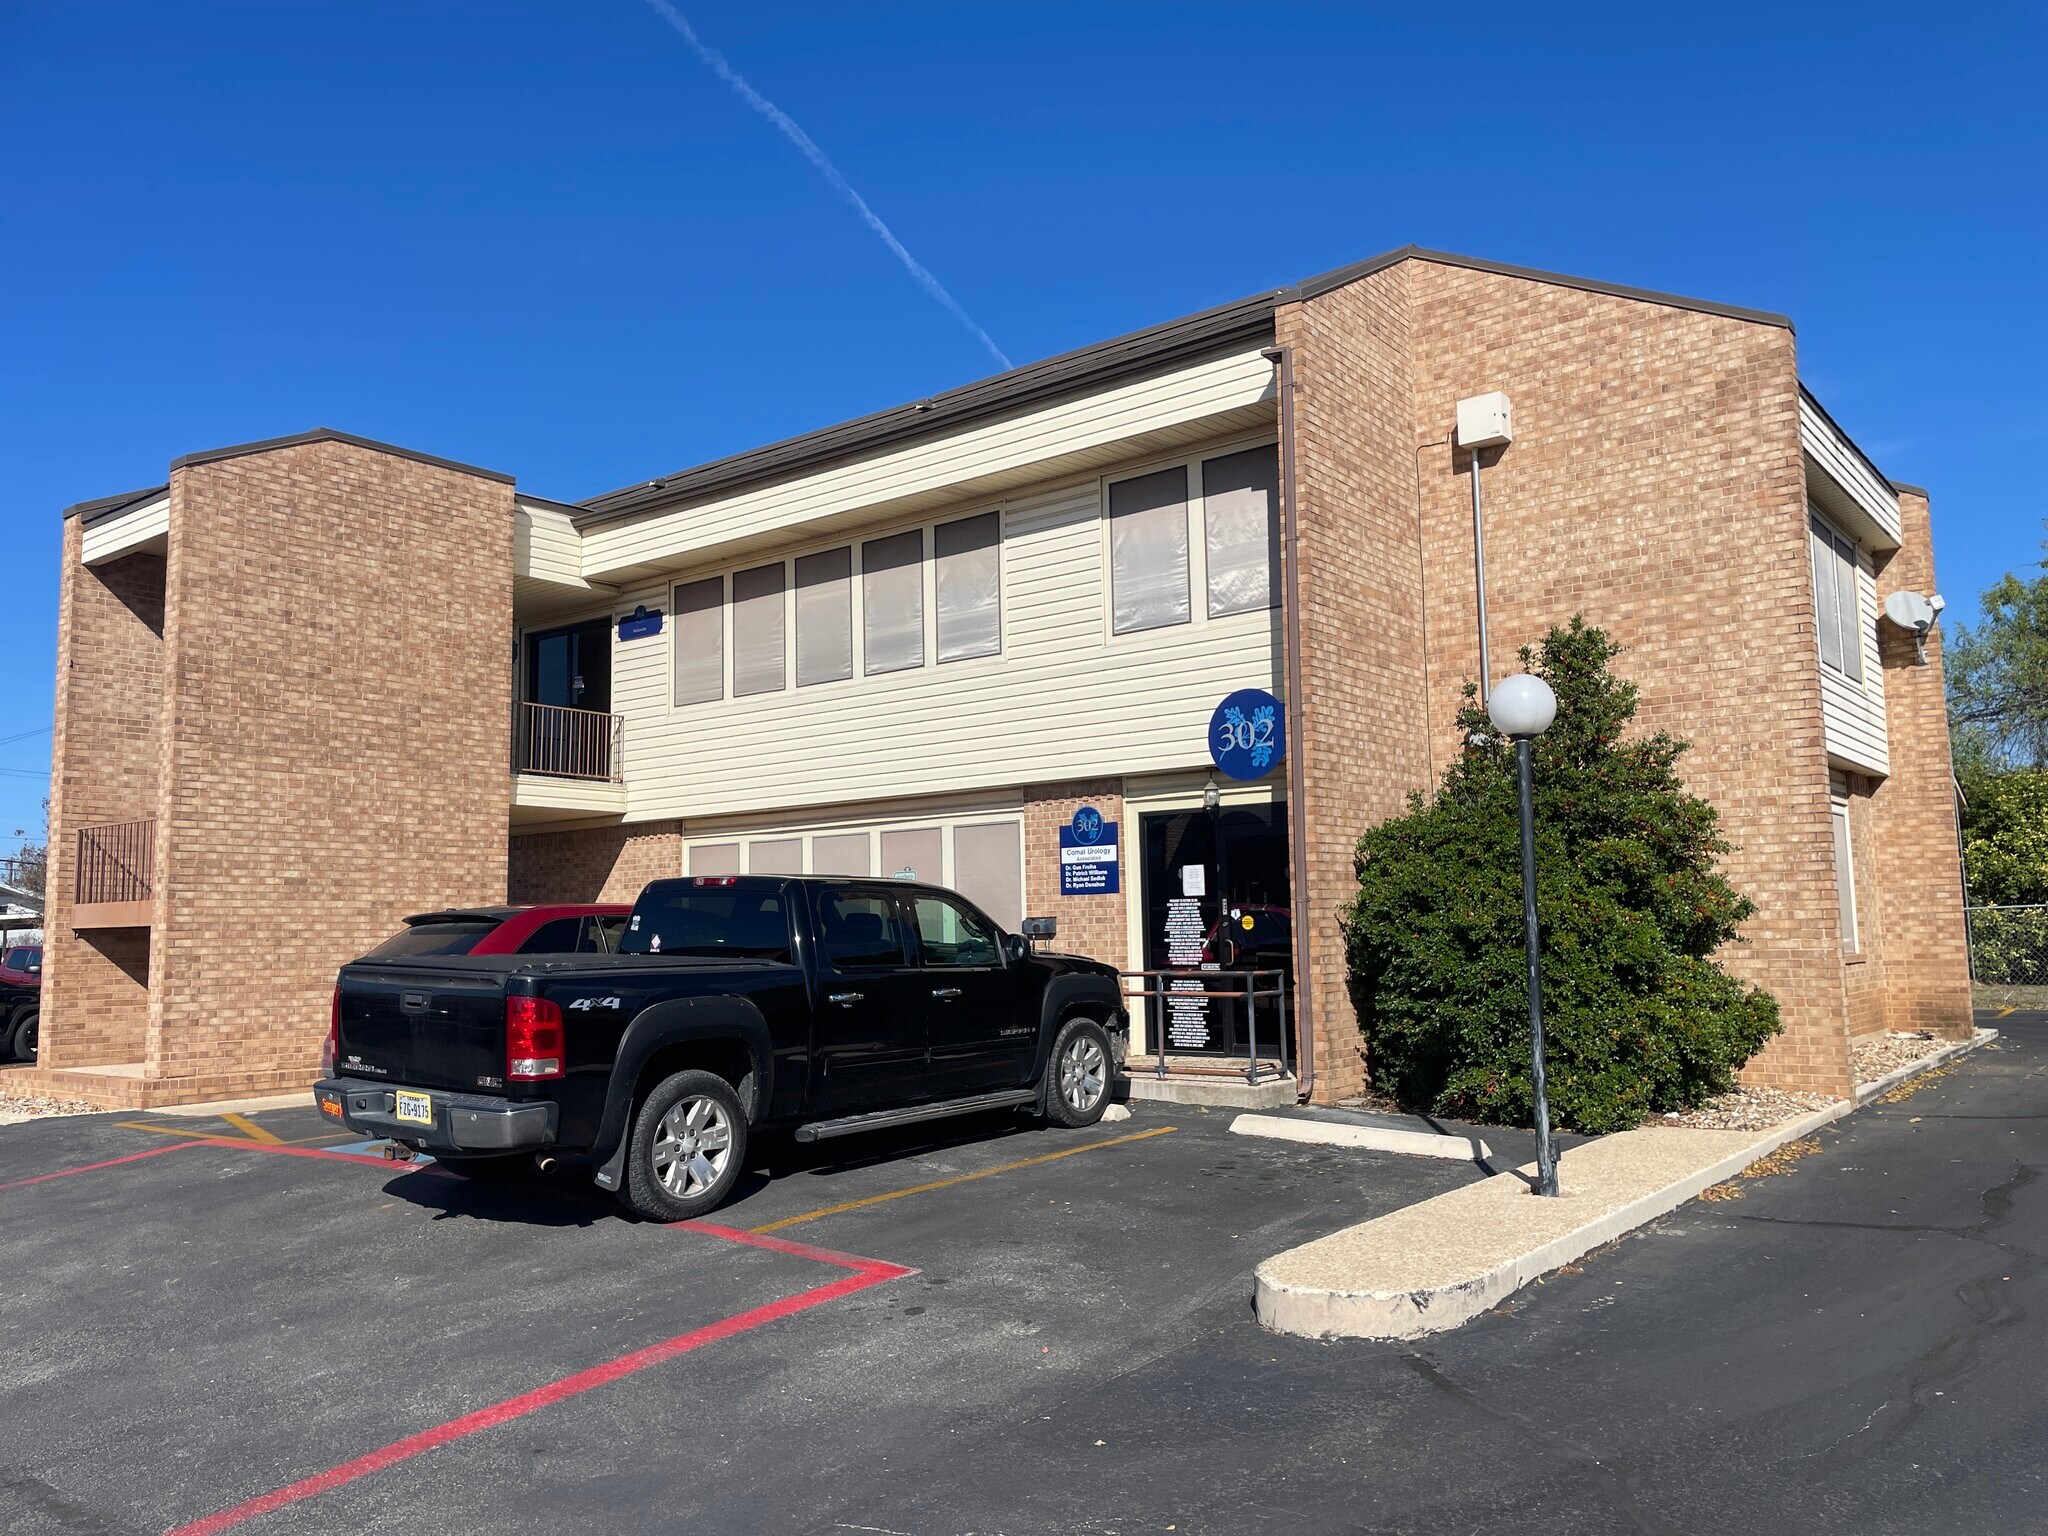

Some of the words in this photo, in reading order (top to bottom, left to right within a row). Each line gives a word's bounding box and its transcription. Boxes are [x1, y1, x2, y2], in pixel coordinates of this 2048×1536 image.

[1218, 719, 1275, 752] 302
[1076, 819, 1099, 832] 302
[1087, 847, 1111, 855] Urology
